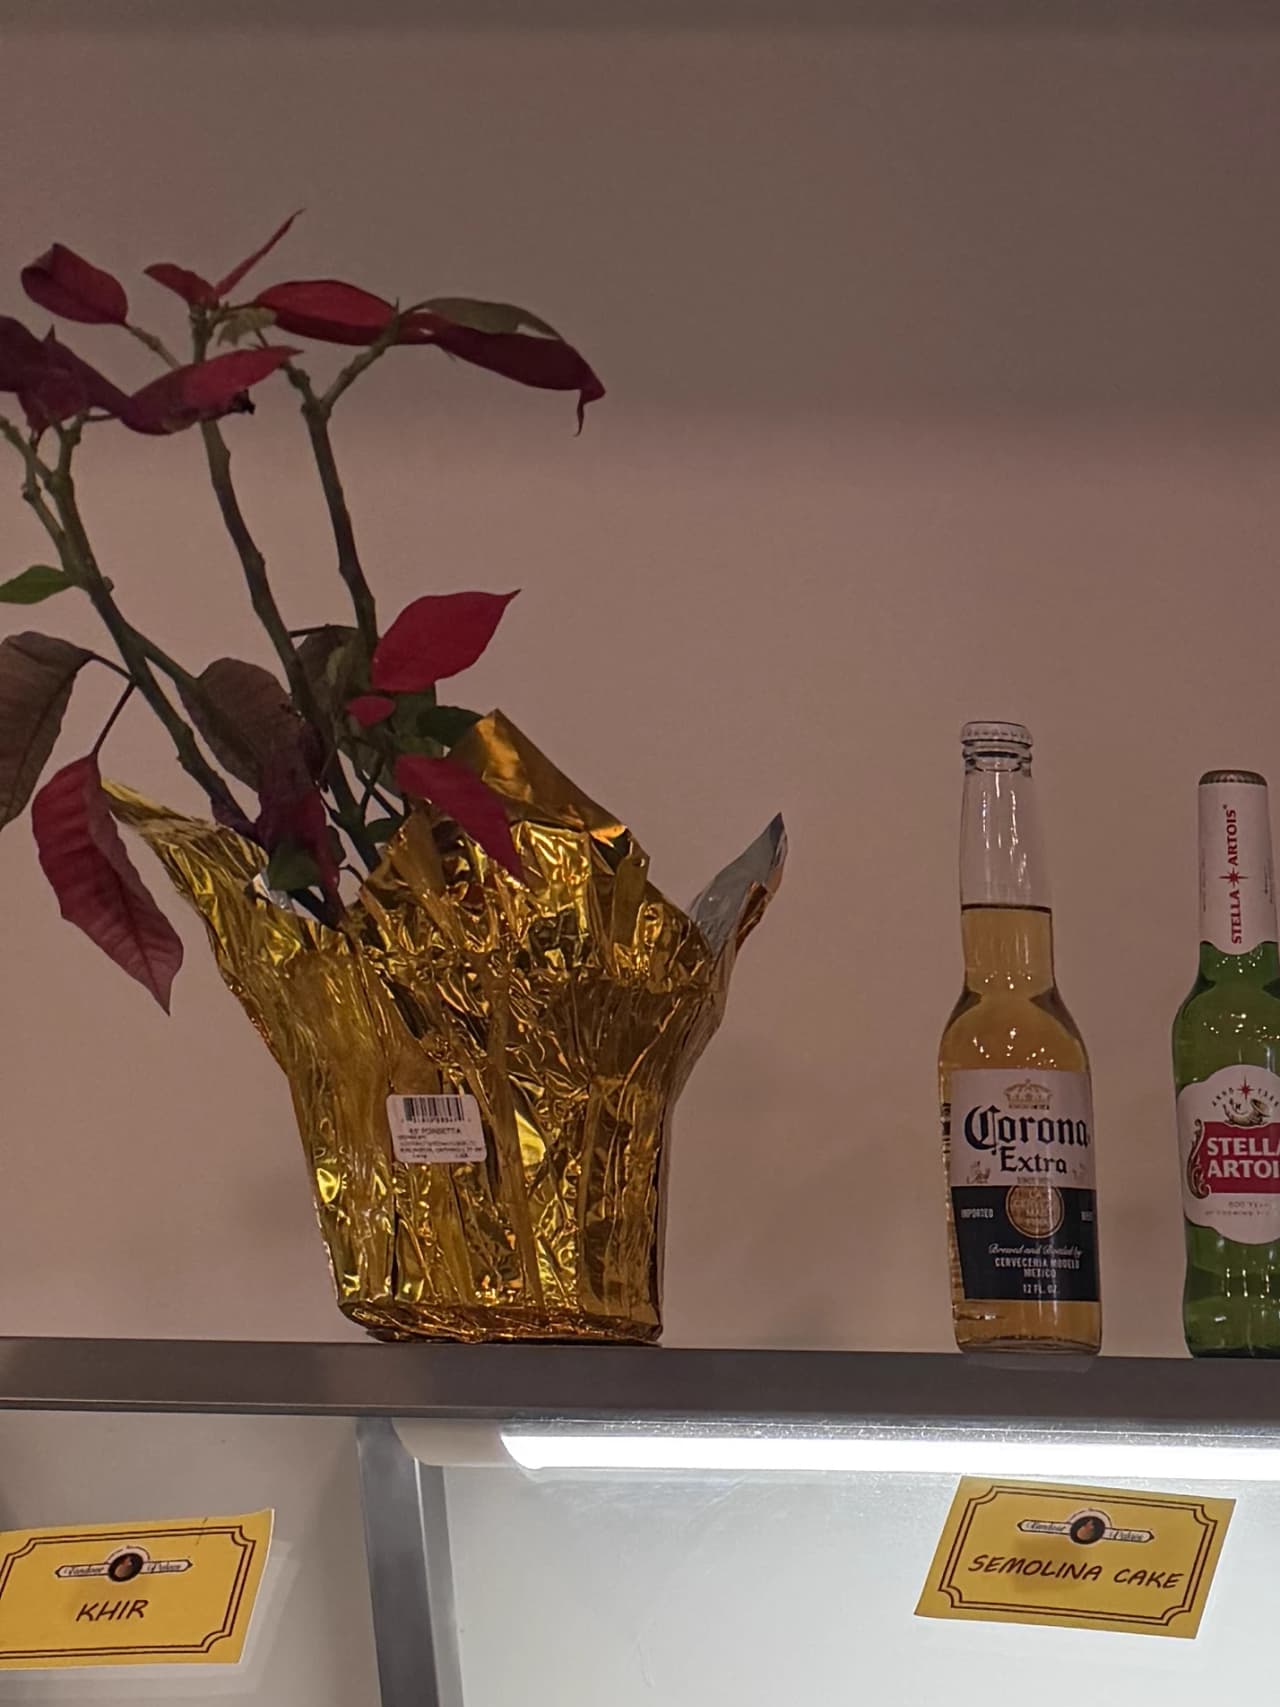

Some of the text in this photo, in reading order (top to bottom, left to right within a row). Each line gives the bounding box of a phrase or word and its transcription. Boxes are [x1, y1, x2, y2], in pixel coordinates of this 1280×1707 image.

[1226, 809, 1242, 944] STELLA ARTOIS
[963, 1104, 1090, 1155] Corona
[1000, 1146, 1068, 1174] Extra
[967, 1554, 1185, 1589] SEMOLINA CAKE
[76, 1599, 149, 1622] KHIR
